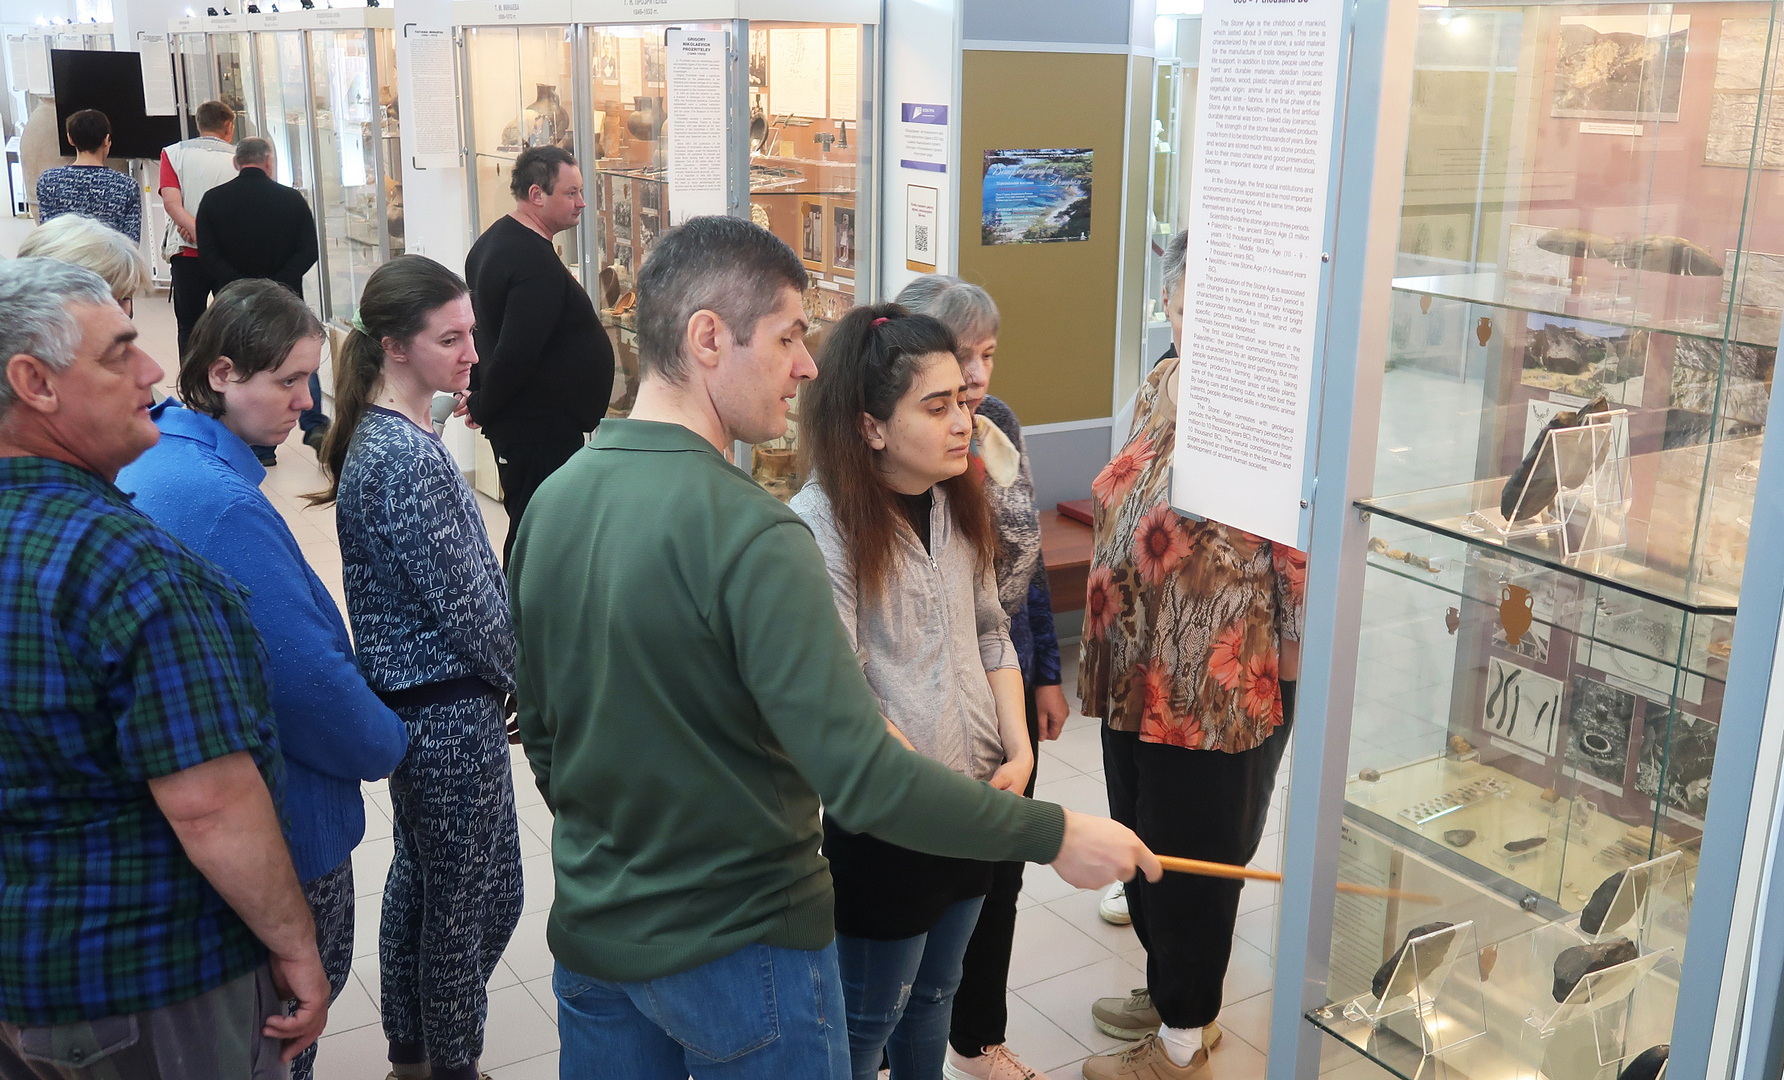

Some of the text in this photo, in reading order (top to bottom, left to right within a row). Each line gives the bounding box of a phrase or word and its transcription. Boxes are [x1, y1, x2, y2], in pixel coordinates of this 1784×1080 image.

[1277, 49, 1298, 57] designed
[1224, 122, 1242, 131] strength
[1297, 128, 1319, 136] products
[1230, 160, 1251, 169] important
[1294, 166, 1315, 174] historical
[1203, 184, 1223, 192] economic
[1223, 186, 1245, 194] structures
[1245, 189, 1266, 198] appeared
[1290, 194, 1313, 204] important
[1206, 283, 1224, 293] changes
[1271, 294, 1283, 302] Each
[1284, 297, 1299, 306] period
[1253, 282, 1267, 290] Stone
[1266, 284, 1276, 293] Age
[1280, 287, 1306, 297] associated
[1195, 307, 1211, 316] specific
[1213, 311, 1232, 321] products
[1235, 315, 1247, 323] made
[1263, 320, 1275, 328] stone
[1278, 323, 1287, 331] and
[1290, 326, 1302, 334] other
[1221, 330, 1234, 338] social
[1235, 333, 1256, 342] formation
[1268, 340, 1285, 349] formed
[1192, 358, 1207, 367] learned
[1209, 363, 1232, 374] productive
[1234, 368, 1251, 379] farming
[1283, 380, 1298, 390] taking
[1208, 406, 1220, 414] Stone
[1223, 410, 1232, 418] Age
[1259, 419, 1268, 427] with
[1271, 422, 1294, 435] geological
[1186, 442, 1212, 456] development
[1217, 451, 1233, 461] ancient
[1233, 456, 1248, 465] human
[389, 494, 418, 513] Rome
[438, 592, 472, 613] Rome
